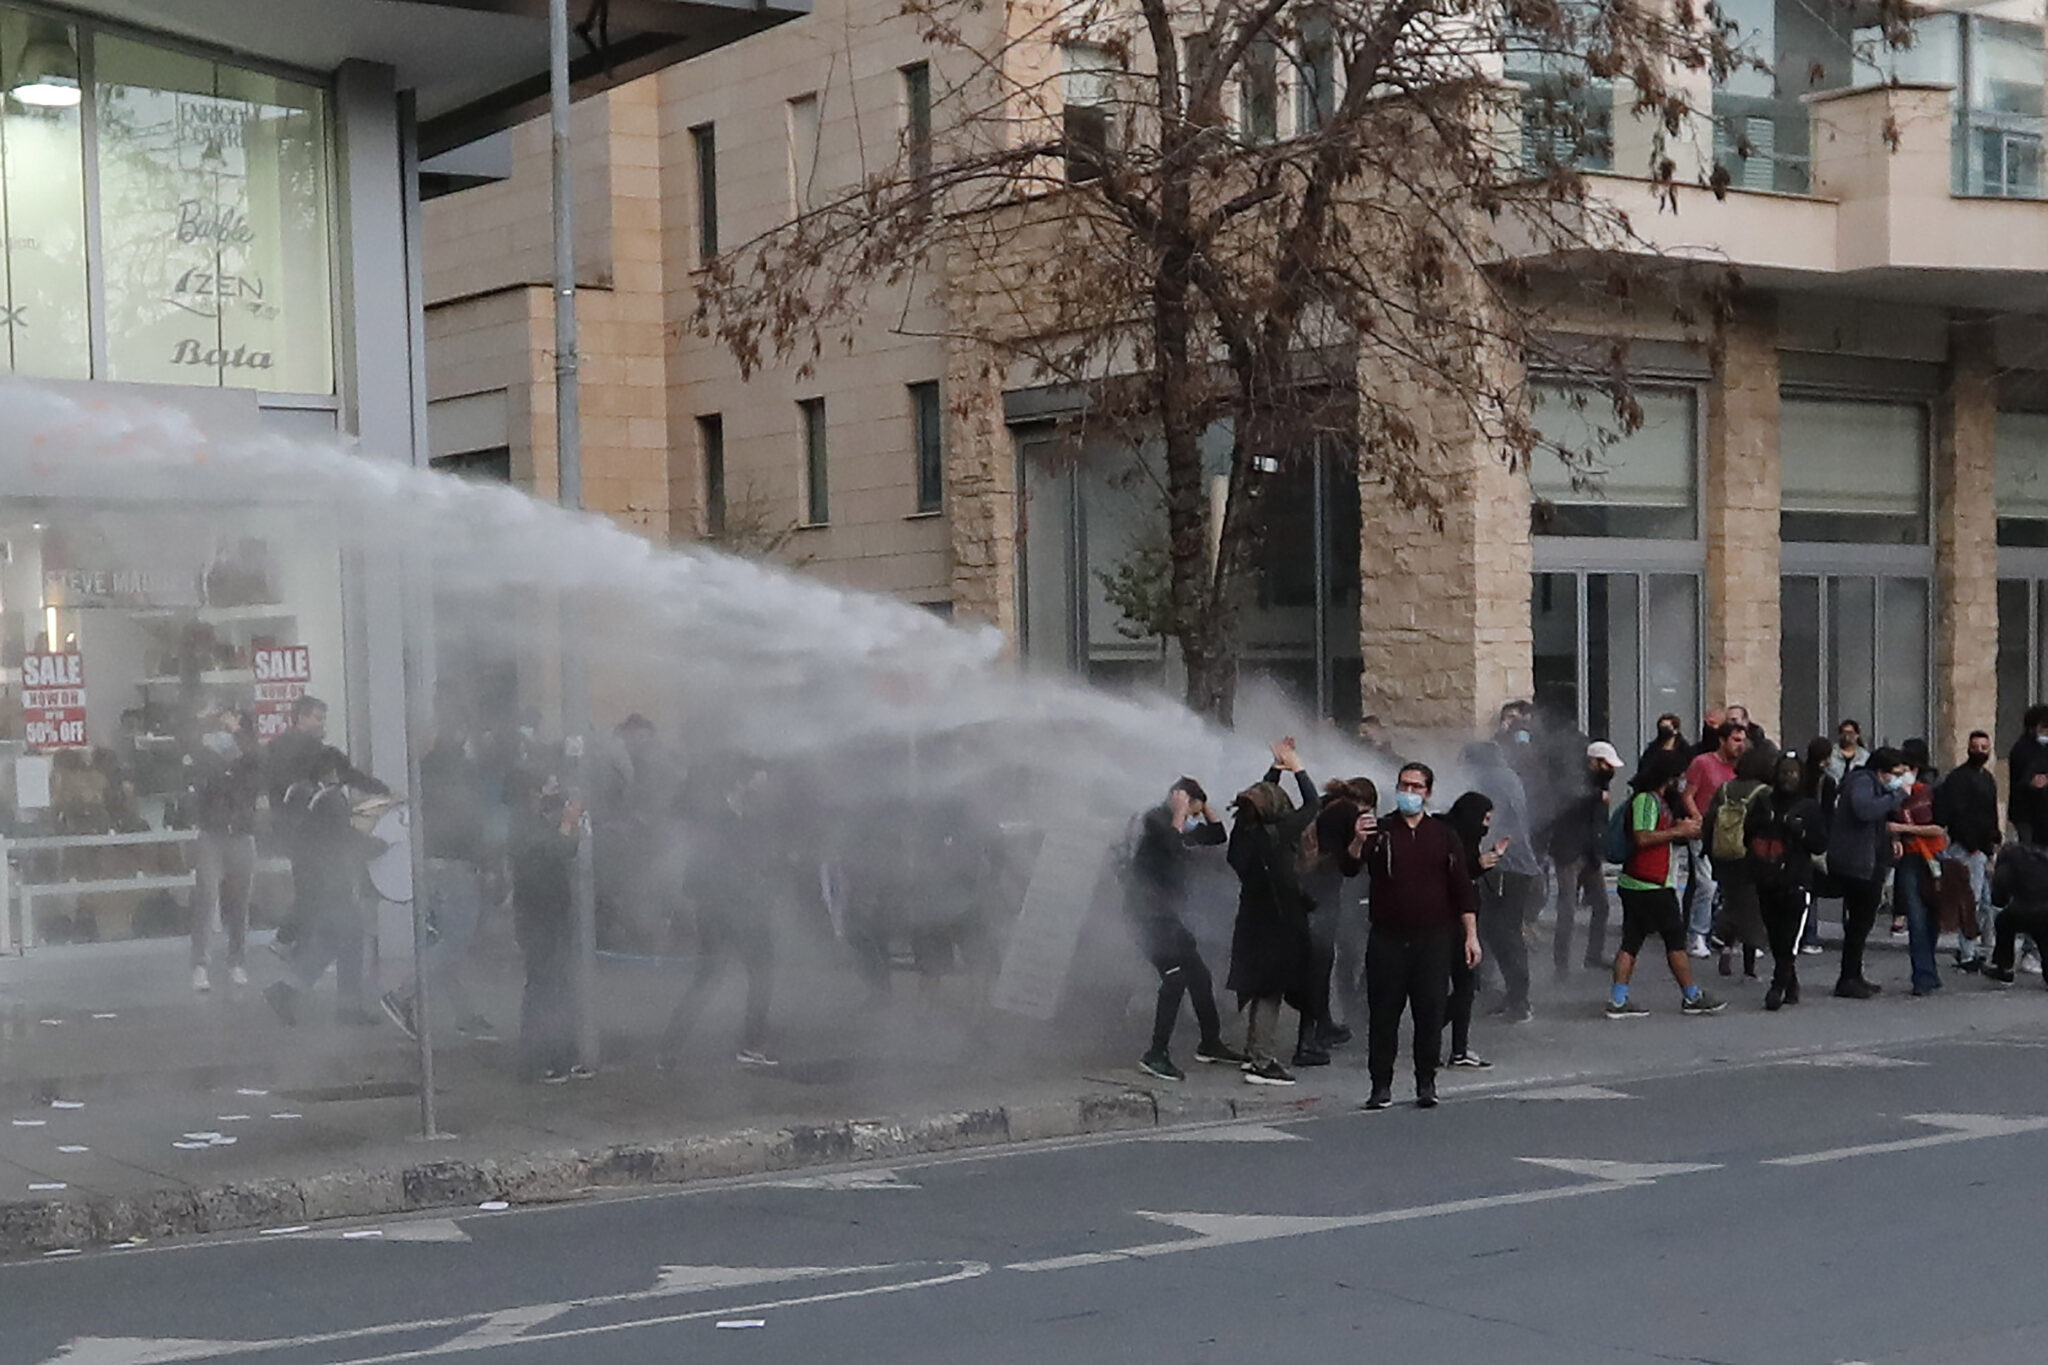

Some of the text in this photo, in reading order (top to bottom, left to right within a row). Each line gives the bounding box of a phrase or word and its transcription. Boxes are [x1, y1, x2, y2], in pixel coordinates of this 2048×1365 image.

[170, 339, 274, 369] Bata
[23, 655, 81, 685] SALE
[254, 651, 308, 680] SALE
[60, 720, 84, 742] OFF
